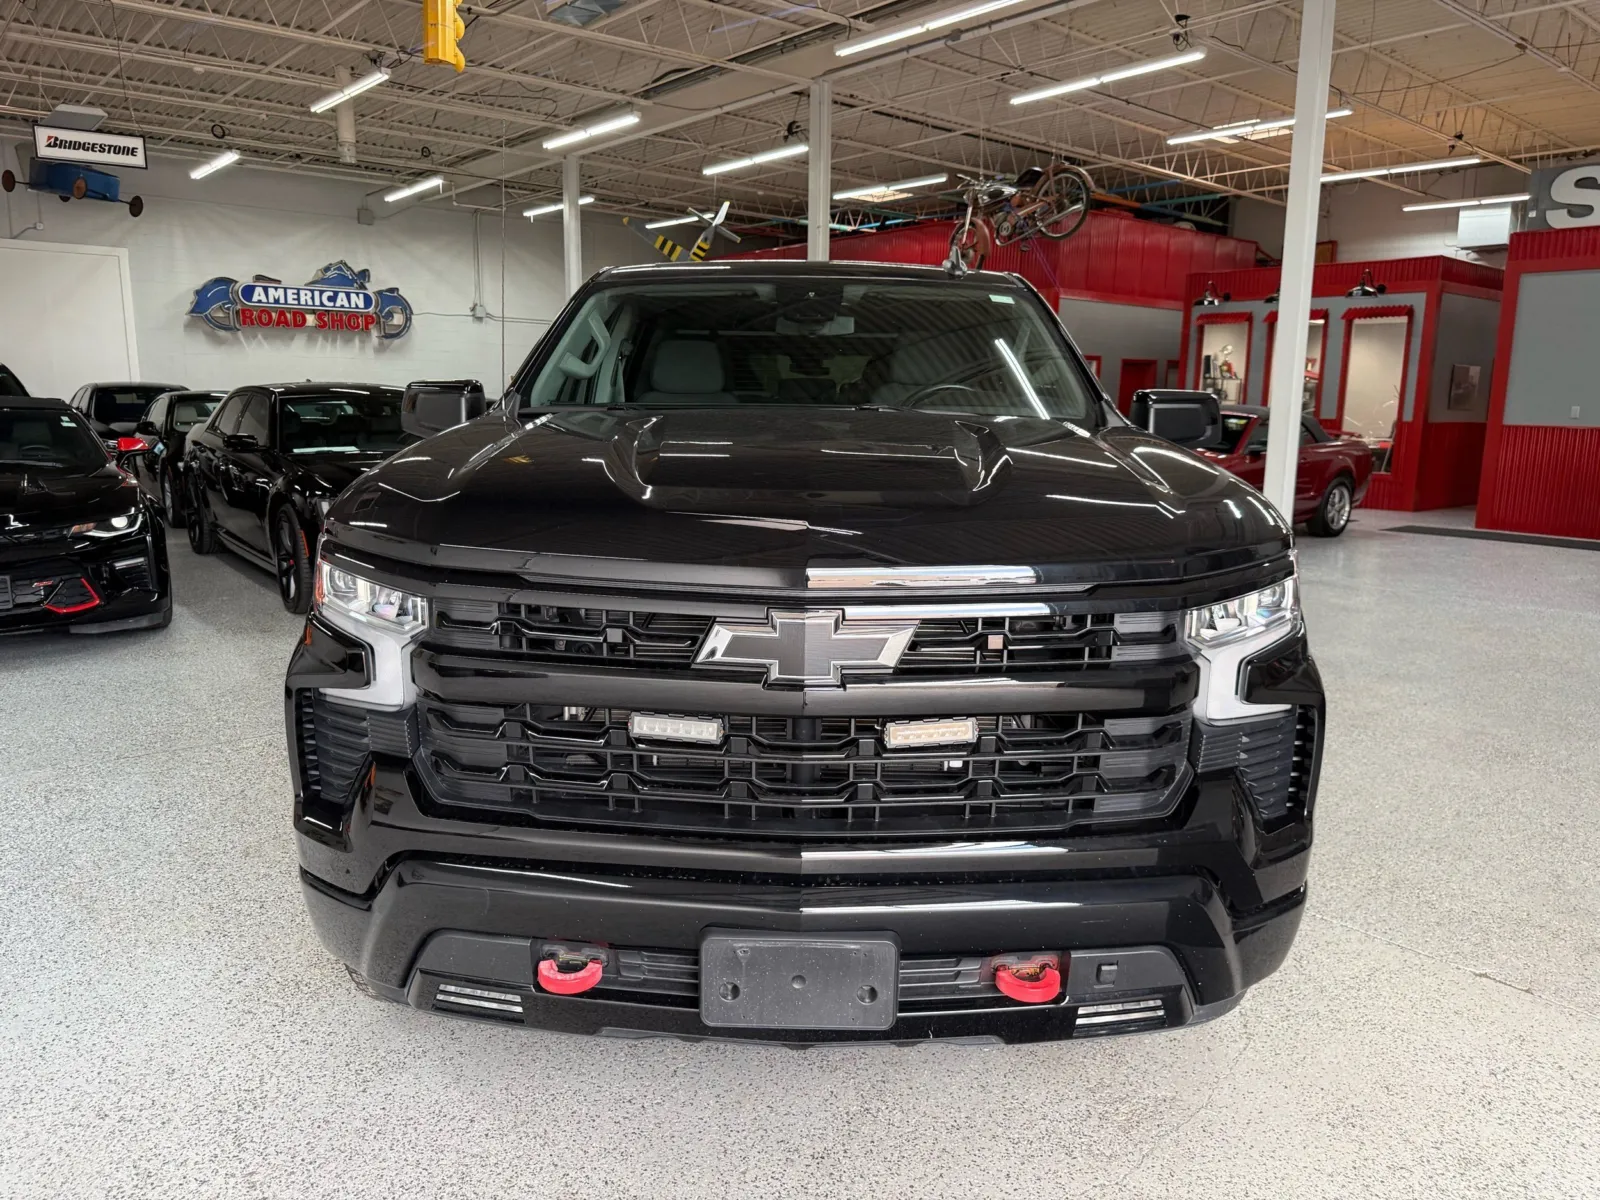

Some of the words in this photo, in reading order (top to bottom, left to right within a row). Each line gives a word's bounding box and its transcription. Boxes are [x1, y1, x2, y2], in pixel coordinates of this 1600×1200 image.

[45, 135, 139, 157] BRIDGESTONE
[251, 286, 365, 309] AMERICAN
[240, 308, 307, 329] ROAD
[316, 311, 376, 332] SHOP
